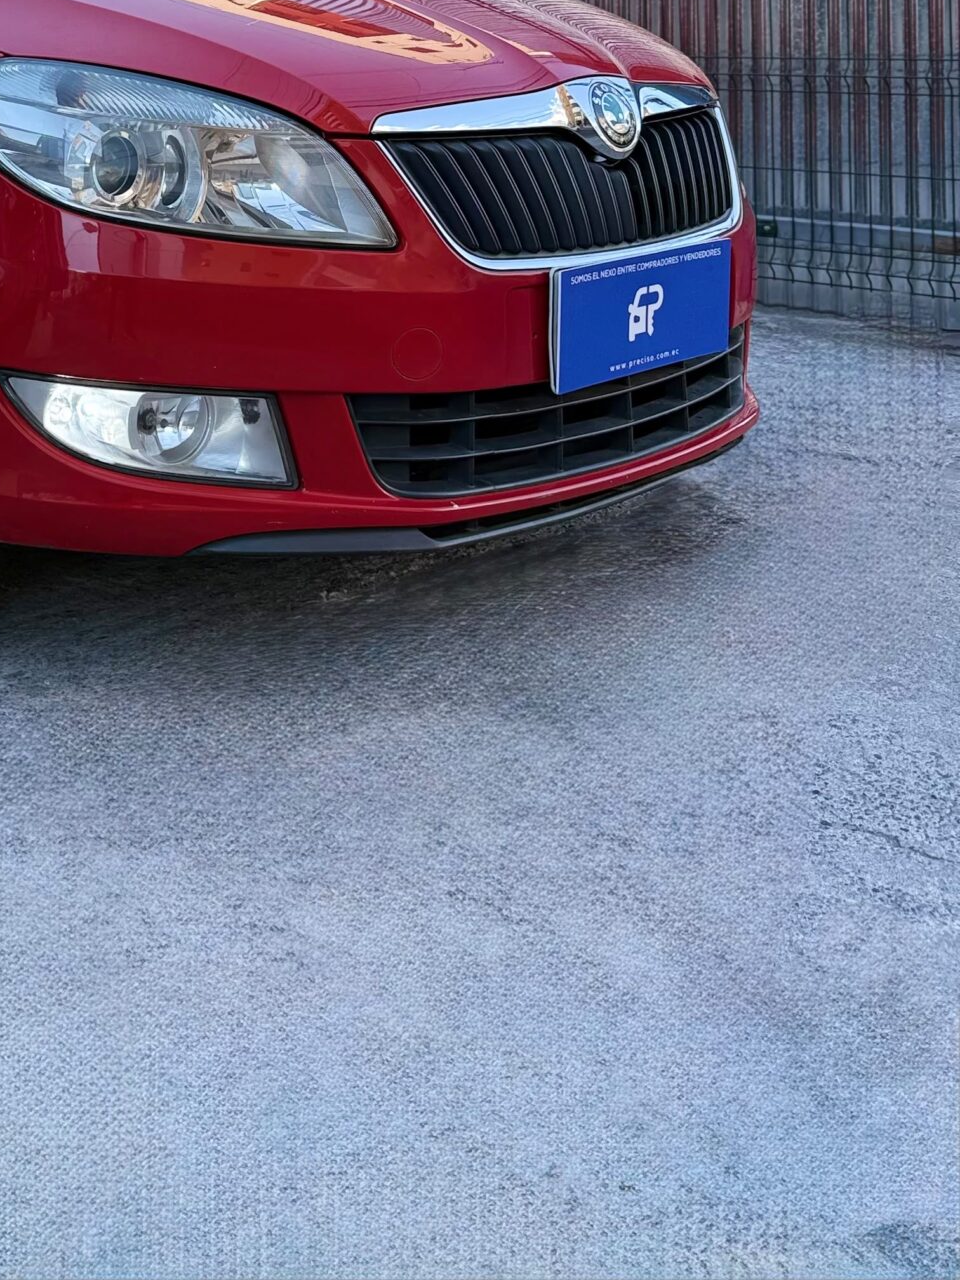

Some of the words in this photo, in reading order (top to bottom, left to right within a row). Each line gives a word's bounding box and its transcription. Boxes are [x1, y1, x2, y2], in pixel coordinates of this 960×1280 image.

[570, 272, 592, 285] SOMOS
[592, 271, 600, 280] EL
[600, 267, 617, 278] NEXO
[617, 263, 636, 275] ENTRE
[636, 255, 679, 271] COMPRADORES
[679, 254, 685, 262] Y
[684, 248, 722, 262] VENDEDORES
